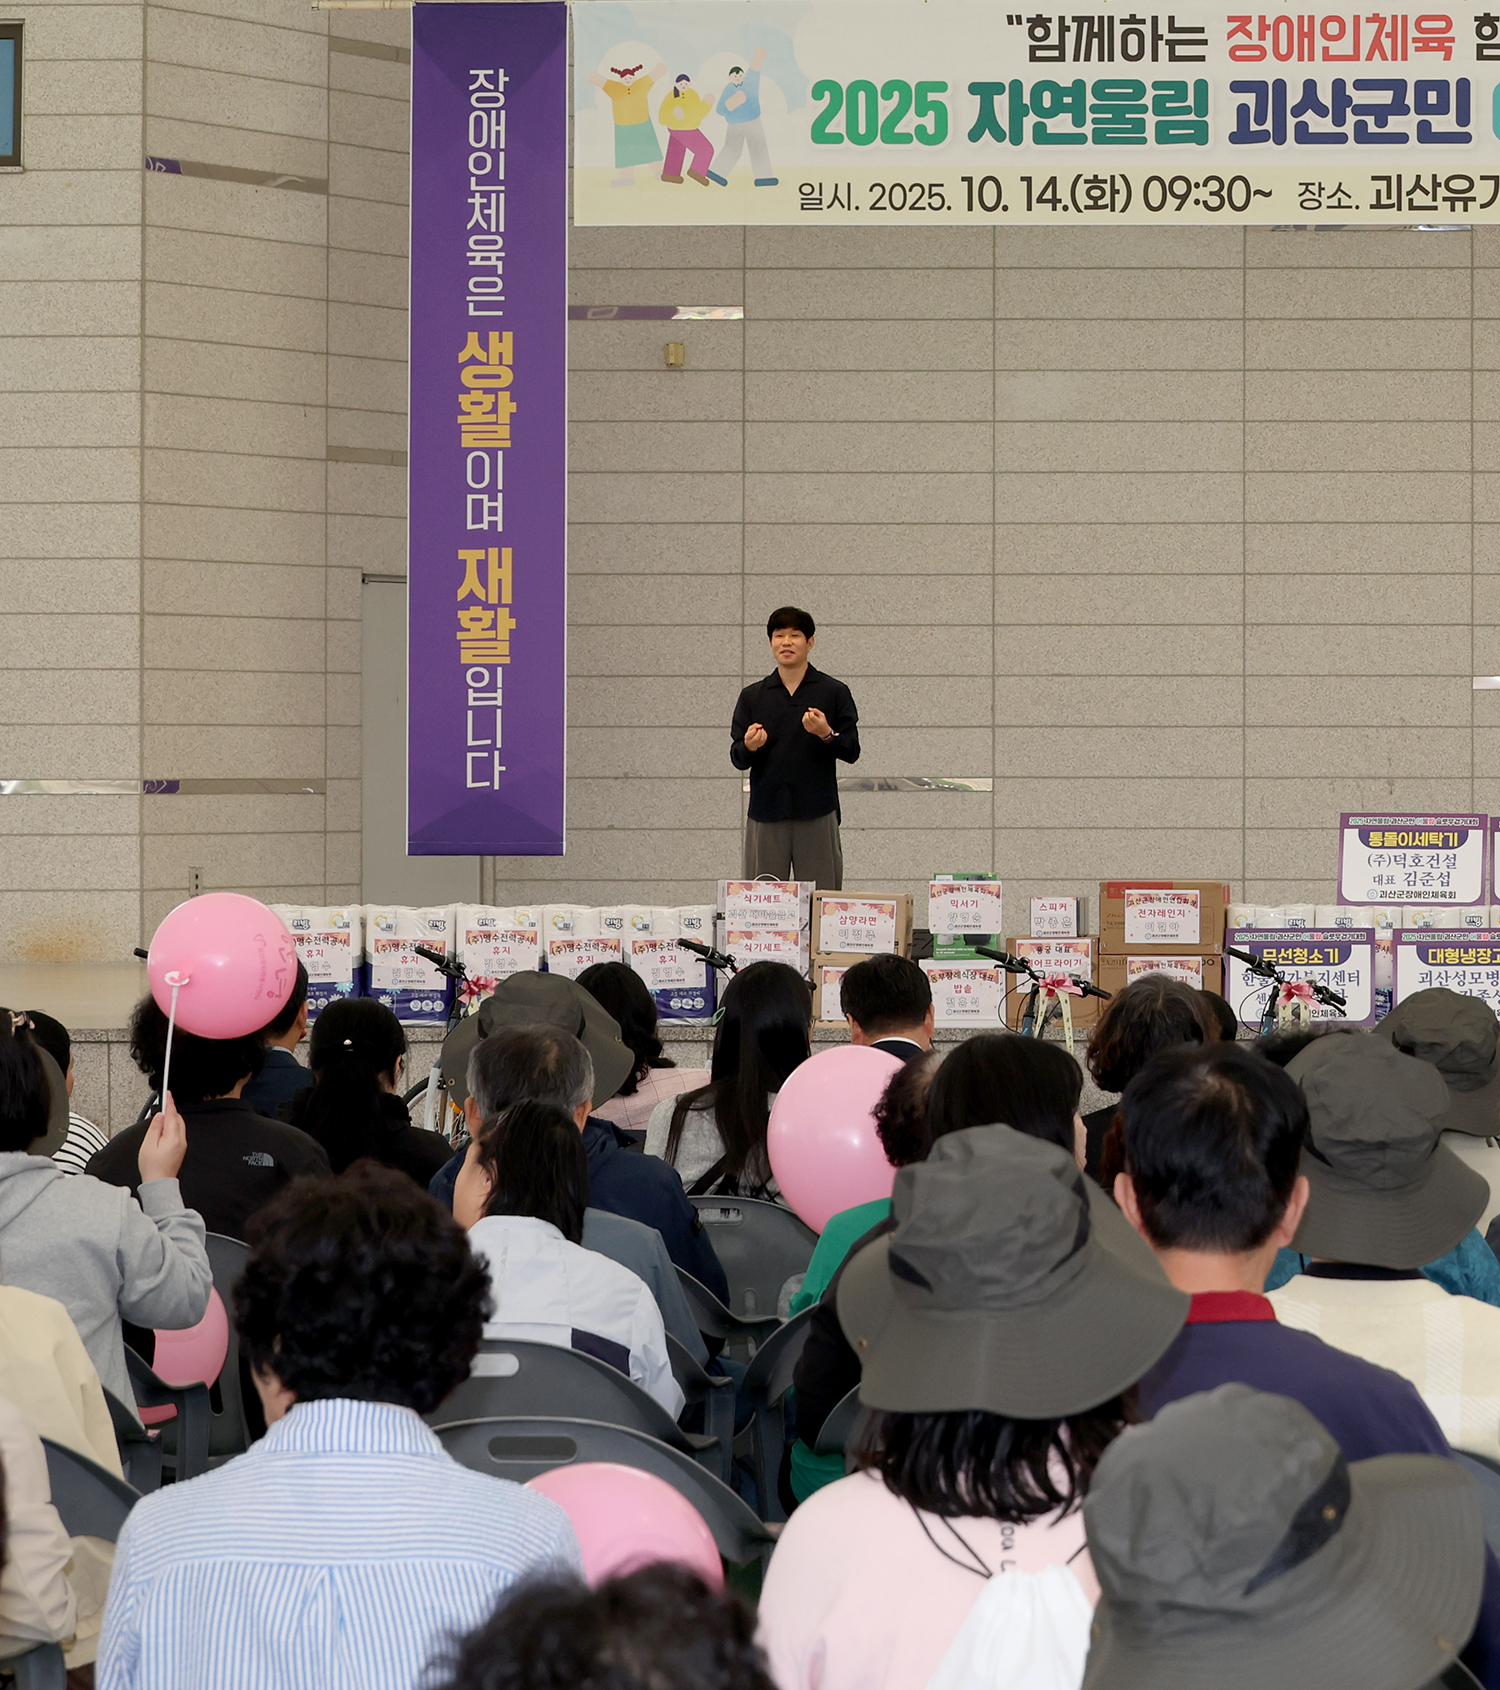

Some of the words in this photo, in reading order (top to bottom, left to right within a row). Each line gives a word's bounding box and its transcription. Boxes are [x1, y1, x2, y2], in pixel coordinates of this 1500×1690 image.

[1227, 13, 1455, 62] 장애인체육
[810, 79, 949, 146] 2025
[966, 79, 1210, 146] 자연울림
[1228, 79, 1474, 146] 괴산군민
[466, 68, 510, 316] 장애인체육은
[799, 183, 859, 211] 일시.
[869, 183, 951, 211] 2025.
[961, 176, 1008, 212] 10.
[1020, 174, 1132, 213] 14.(화)
[1143, 175, 1272, 212] 09:30~
[1298, 182, 1361, 210] 장소.
[457, 331, 517, 532] 생활이며
[456, 547, 516, 790] 재활입니다
[1369, 831, 1459, 847] 통돌이세탁기
[1367, 853, 1457, 869] (주)덕호건설
[1373, 874, 1396, 886] 대표
[1403, 871, 1451, 887] 김준섭
[744, 895, 781, 903] 식기세트
[1379, 890, 1457, 899] 괴산군장애인체육회
[950, 899, 979, 909] 믹서기
[1039, 902, 1067, 912] 스피커
[1138, 909, 1185, 918] 전자레인지
[839, 915, 877, 926] 삼양라면
[492, 946, 511, 955] 휴지
[744, 943, 781, 952] 식기세트
[306, 949, 324, 958] 휴지
[659, 954, 677, 963] 휴지
[401, 955, 418, 964] 휴지
[576, 955, 594, 964] 휴지
